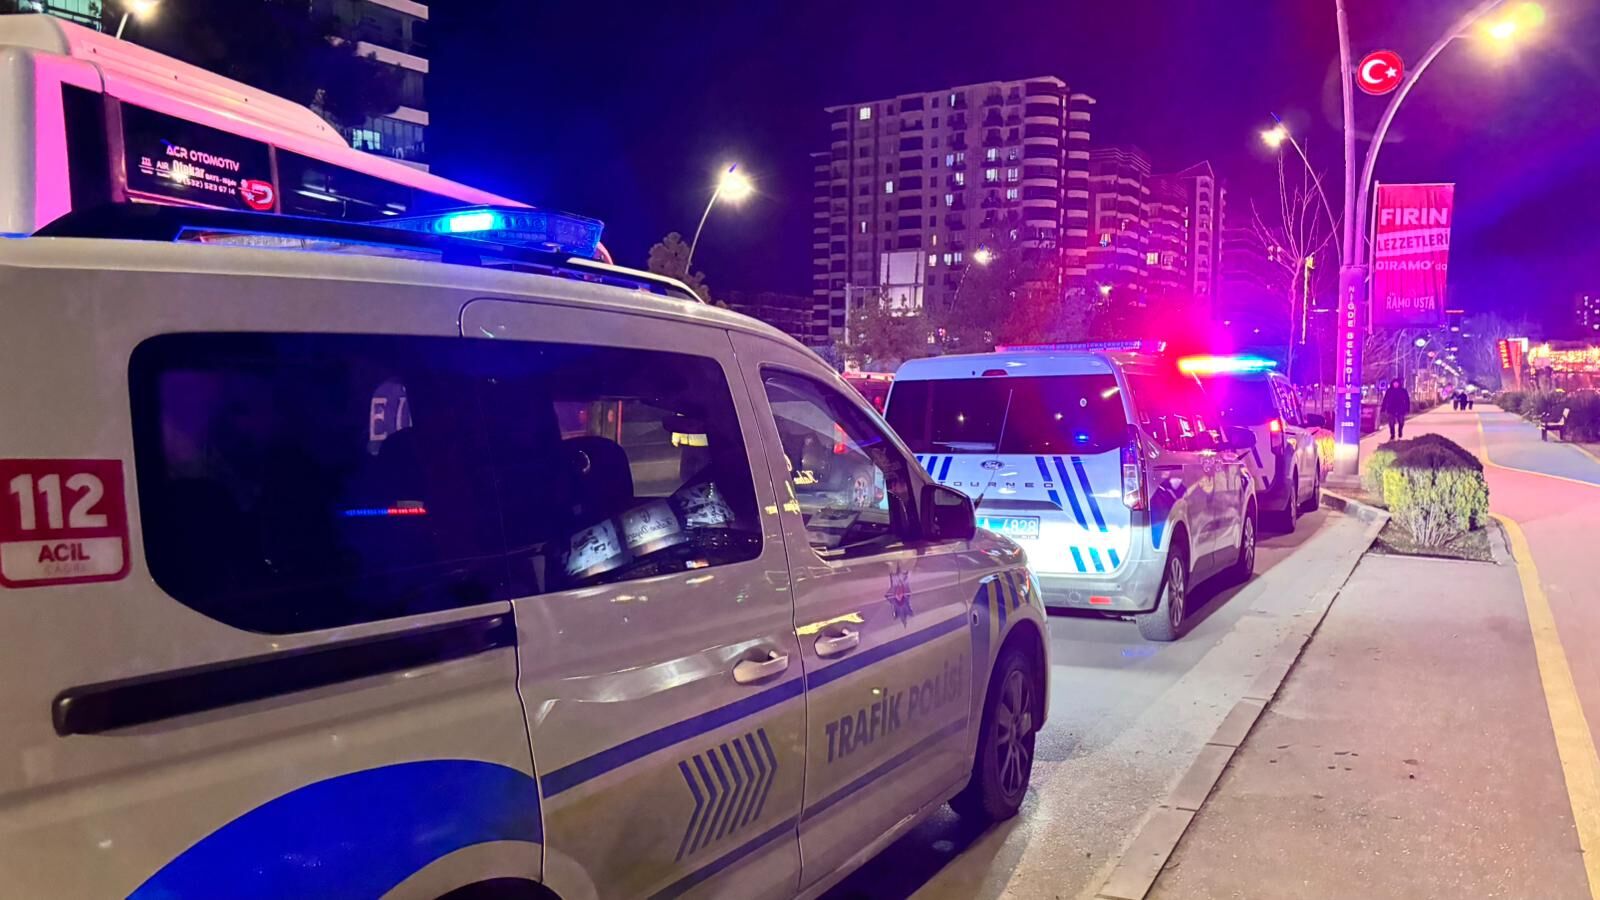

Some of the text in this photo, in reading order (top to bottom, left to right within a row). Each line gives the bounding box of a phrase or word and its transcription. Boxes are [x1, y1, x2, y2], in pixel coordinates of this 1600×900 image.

[1380, 207, 1448, 226] FIRIN
[1377, 230, 1449, 252] LEZZETLERİ
[1386, 296, 1435, 310] RAMO USTA
[937, 480, 1054, 488] TOURNEO
[10, 472, 108, 530] 112
[825, 688, 903, 763] TRAFİK
